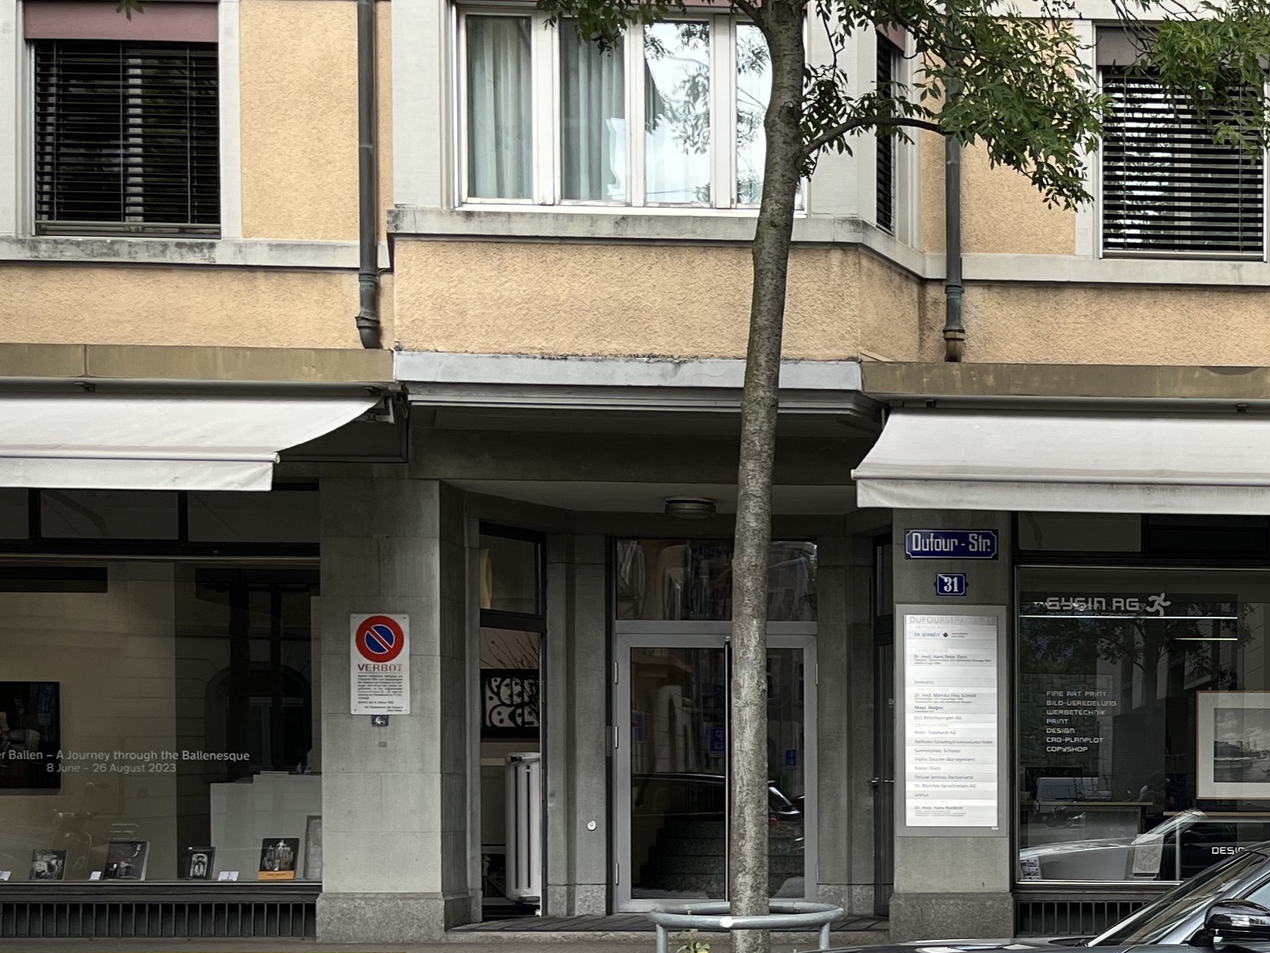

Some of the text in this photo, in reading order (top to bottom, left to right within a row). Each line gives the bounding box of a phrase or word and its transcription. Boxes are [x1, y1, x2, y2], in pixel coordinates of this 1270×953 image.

[912, 533, 958, 551] Dufour
[969, 533, 990, 551] Str.
[943, 577, 959, 592] 31
[1046, 597, 1139, 611] GYSIN AG
[357, 663, 403, 672] VERBOT
[8, 750, 43, 760] Ballen
[56, 750, 64, 760] A
[67, 751, 110, 762] Journey
[113, 751, 158, 762] through
[161, 751, 179, 761] the
[182, 751, 250, 762] Ballenesque
[46, 763, 54, 772] 8
[56, 763, 80, 772] June
[92, 763, 107, 772] 26
[109, 763, 145, 774] August
[149, 763, 176, 772] 2023
